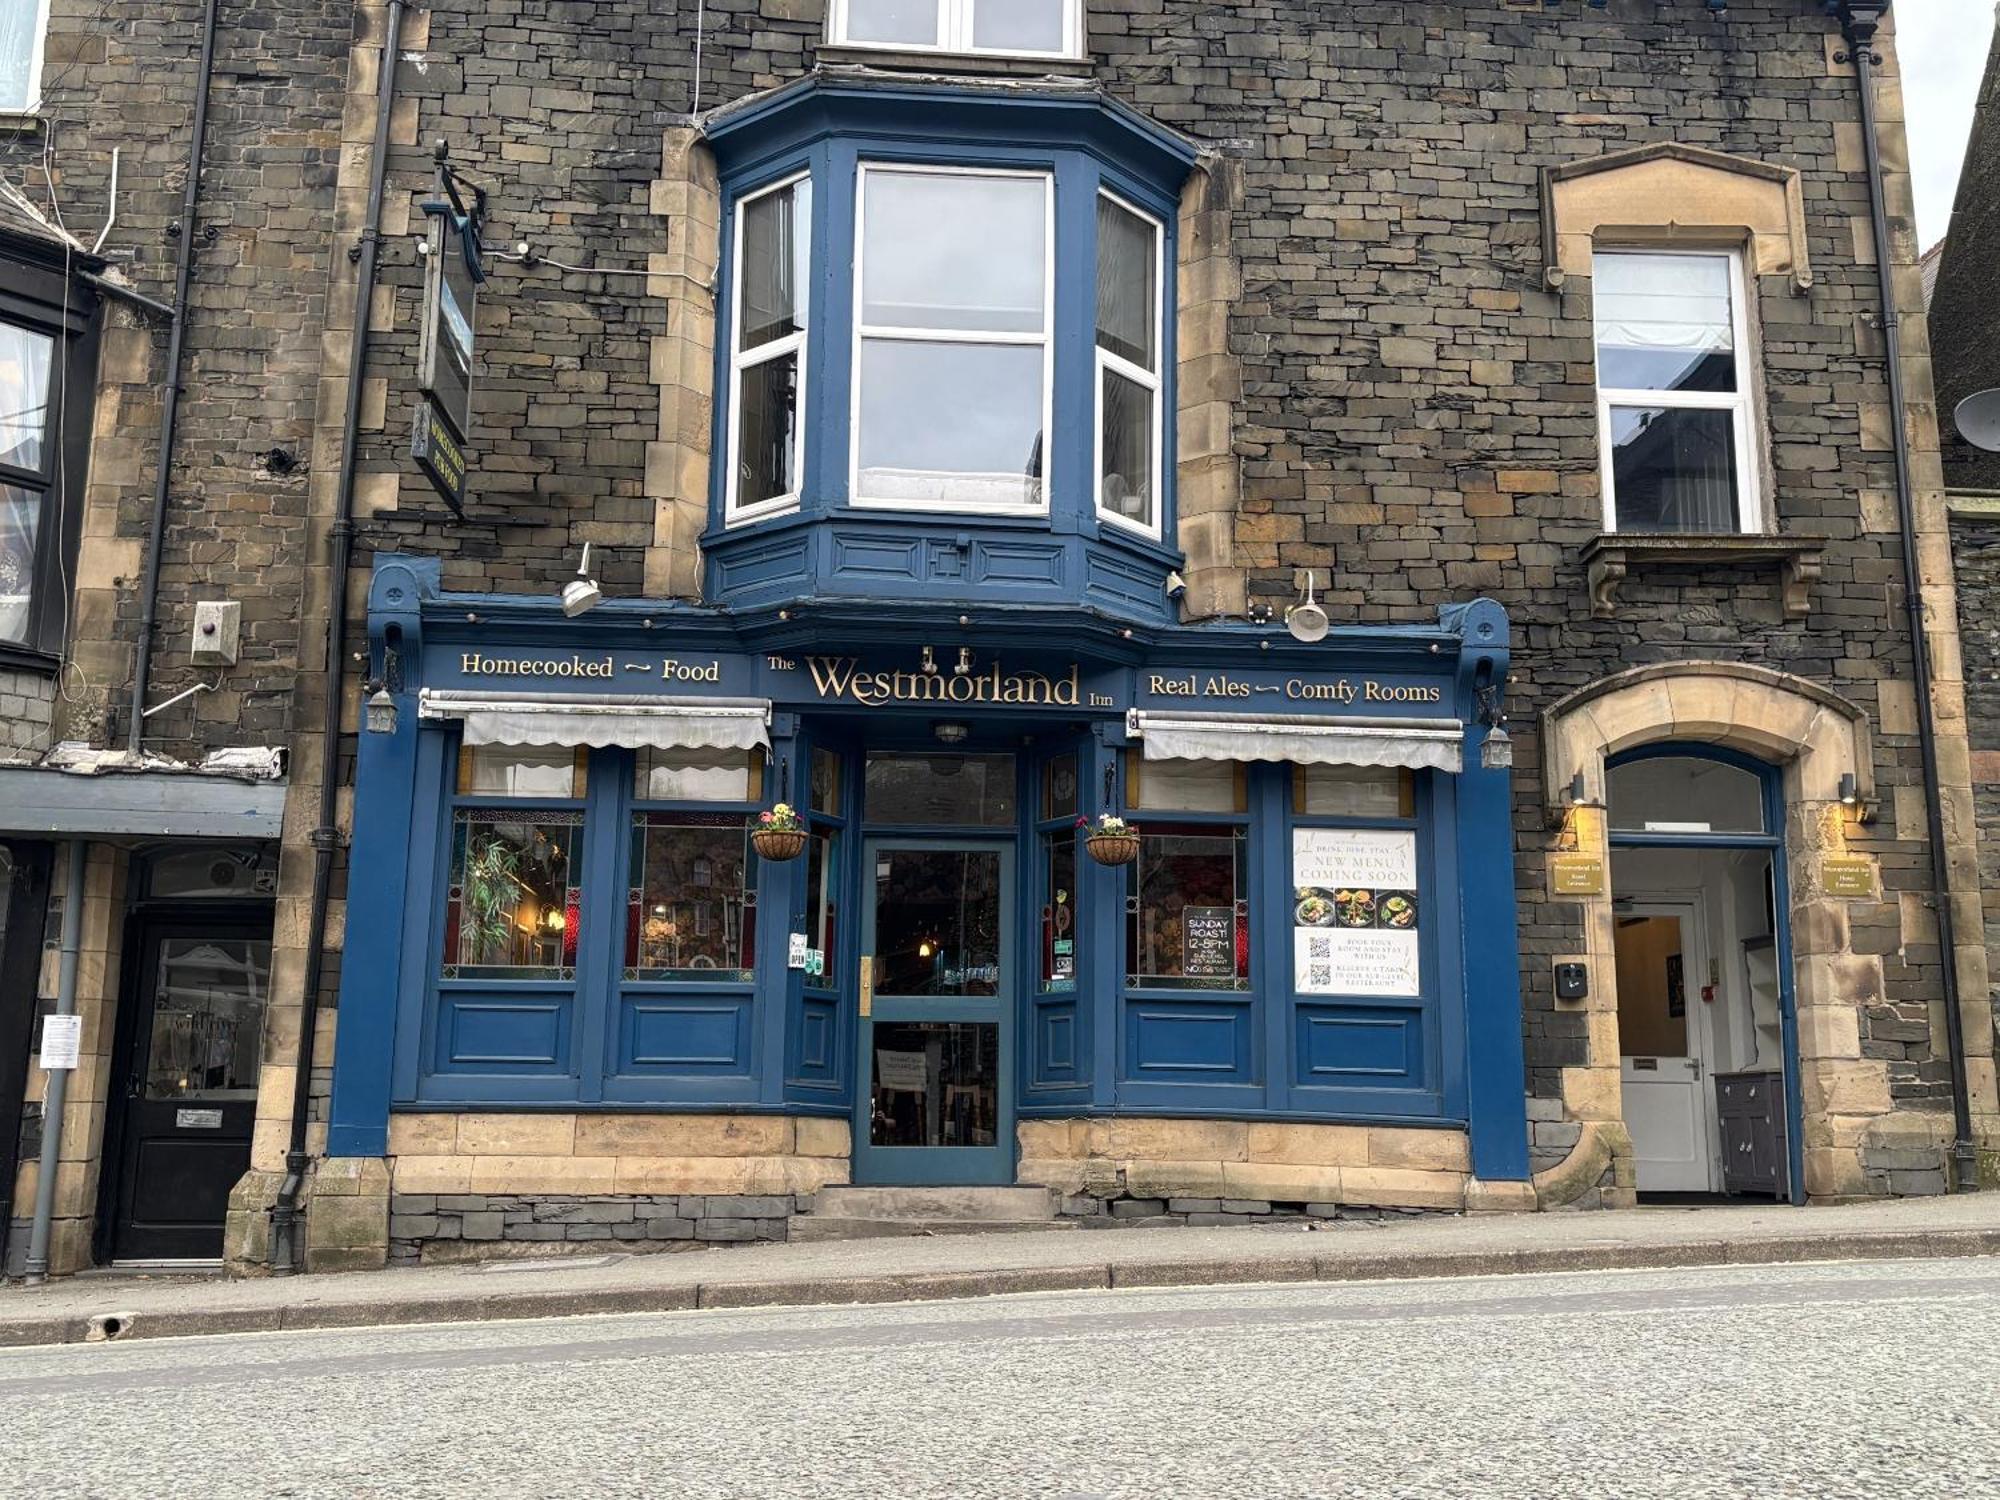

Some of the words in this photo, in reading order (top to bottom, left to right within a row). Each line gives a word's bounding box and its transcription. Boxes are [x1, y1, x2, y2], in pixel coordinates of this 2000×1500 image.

[460, 653, 614, 678] Homecooked
[661, 659, 720, 682] Food
[767, 656, 796, 671] The
[804, 656, 1080, 706] Westmorland
[1089, 693, 1114, 707] Inn
[1149, 675, 1197, 696] Real
[1203, 676, 1250, 697] Ales
[1286, 679, 1358, 704] Comfy
[1364, 681, 1440, 702] Rooms
[1315, 856, 1346, 866] NEW
[1352, 857, 1394, 868] MENU
[1300, 869, 1362, 881] COMING
[1368, 871, 1409, 882] SOON
[1189, 919, 1229, 929] SUNDAY
[1190, 929, 1228, 938] ROAST!
